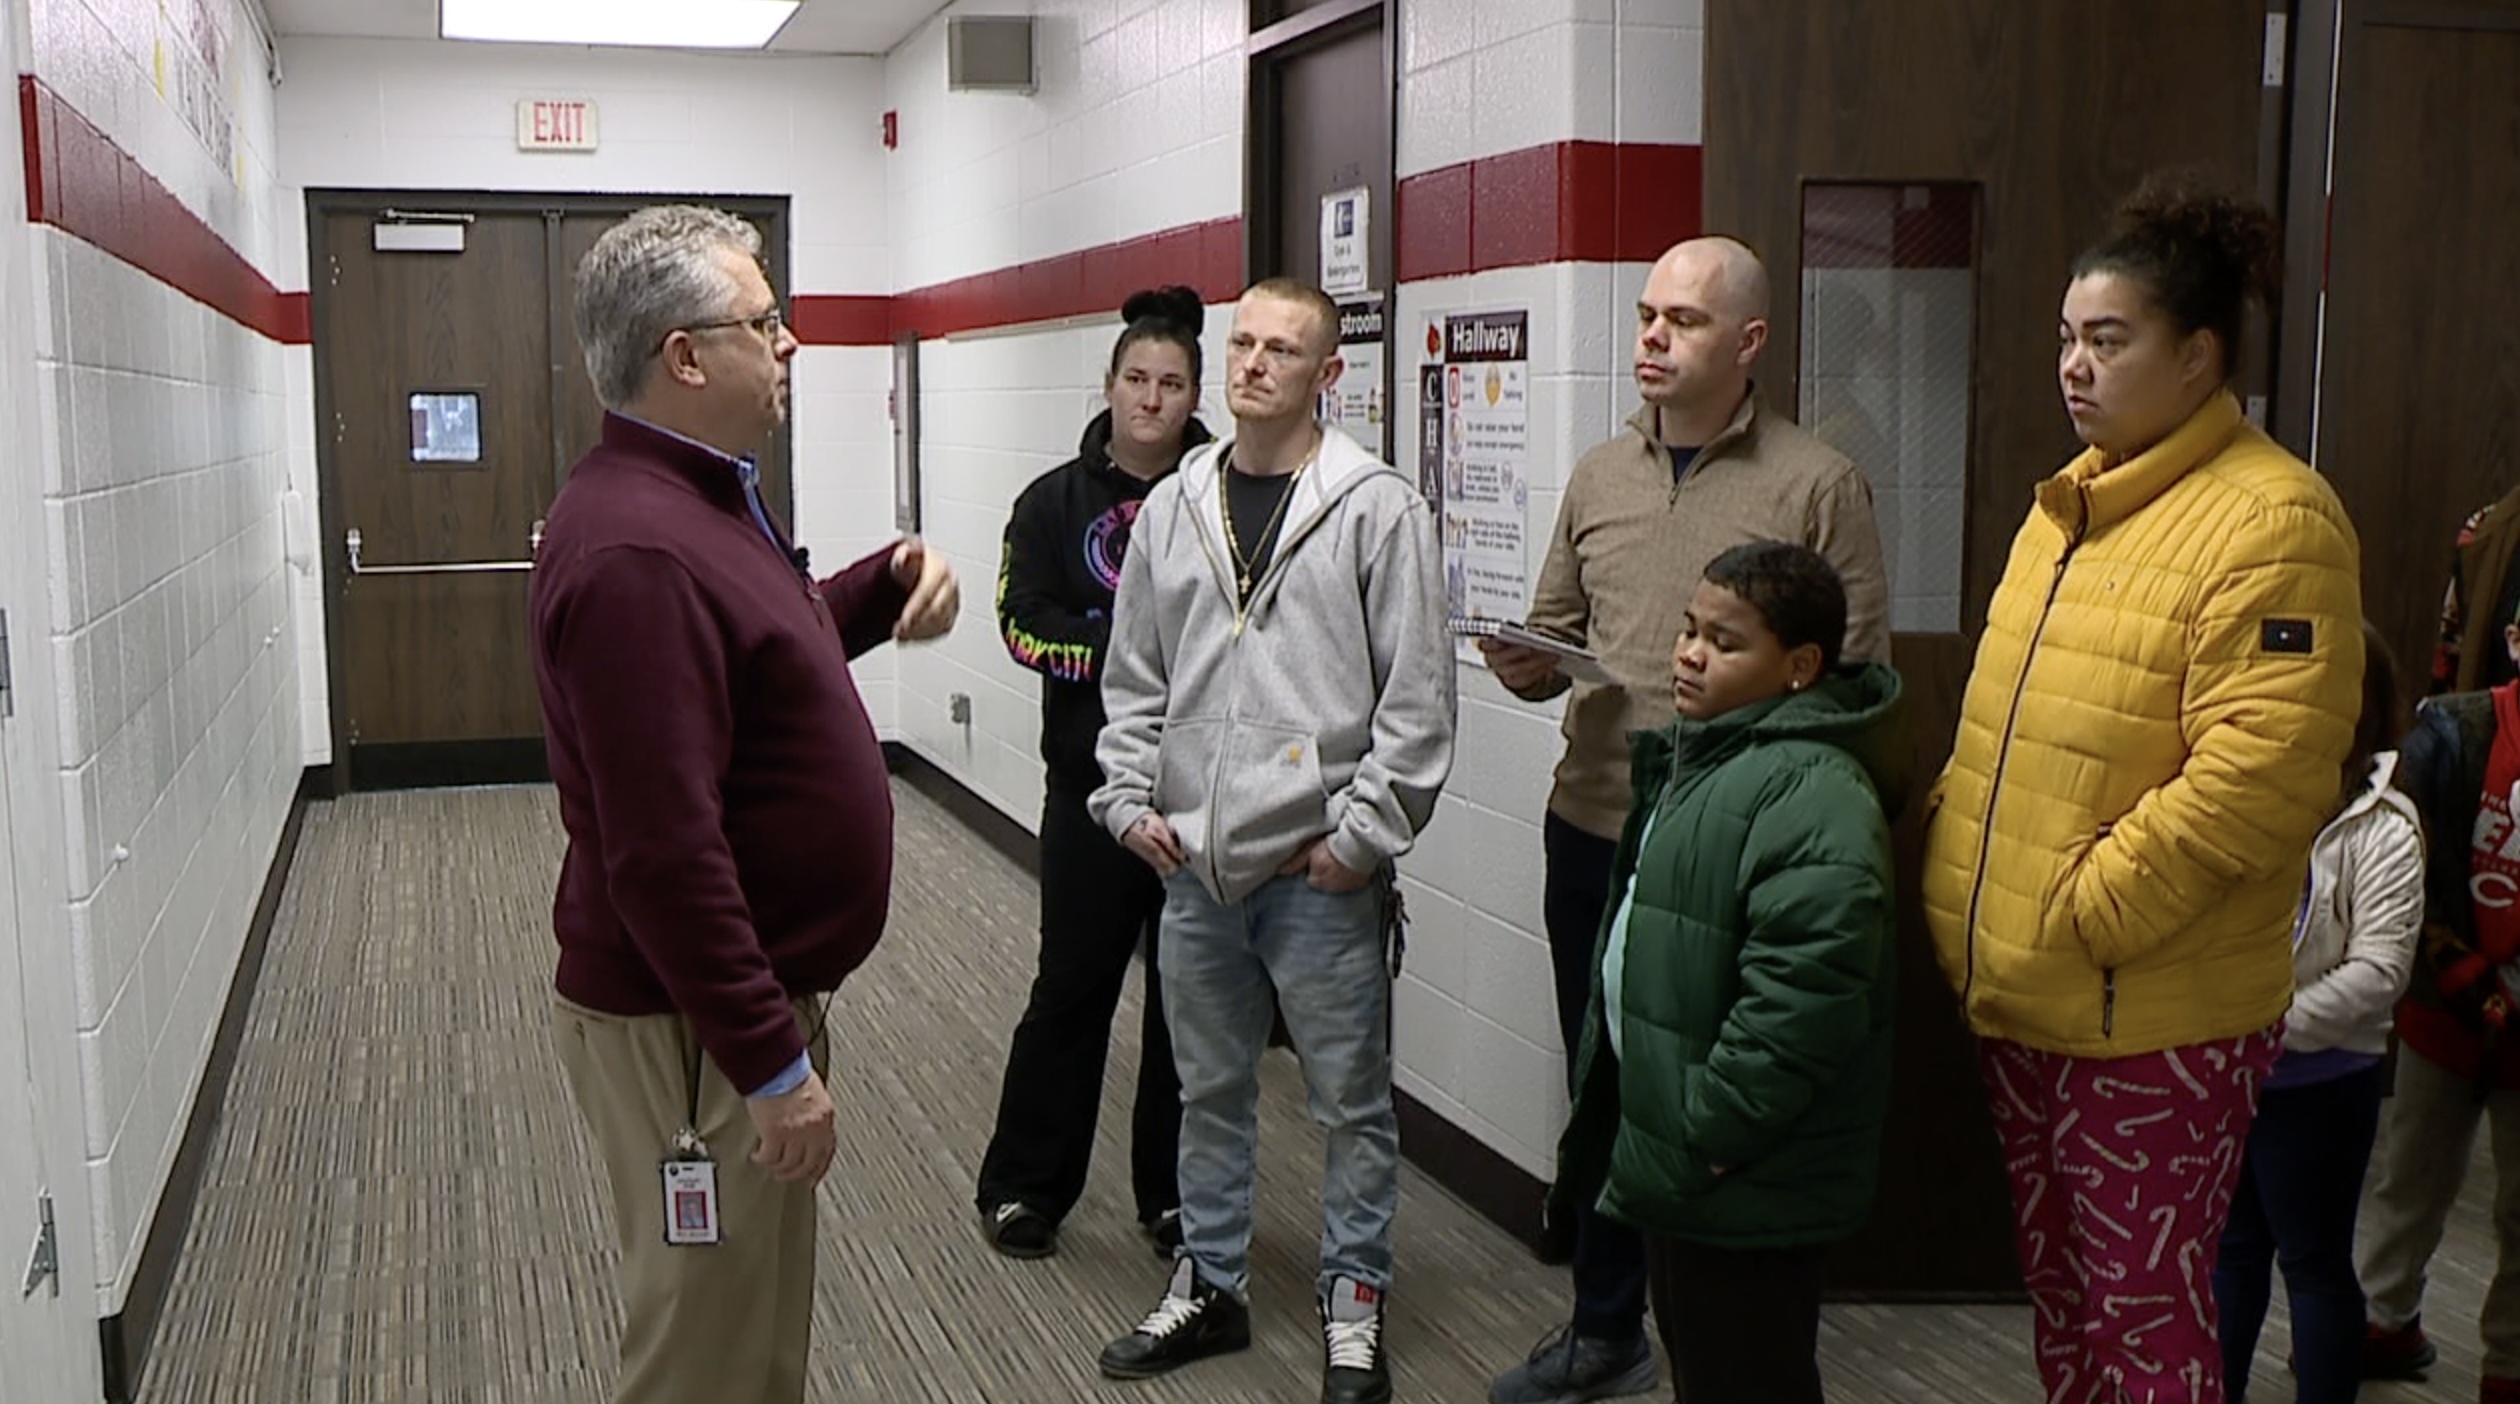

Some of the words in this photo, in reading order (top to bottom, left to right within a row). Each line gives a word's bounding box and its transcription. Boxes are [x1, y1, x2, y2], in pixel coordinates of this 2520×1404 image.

[534, 102, 586, 142] EXIT
[1340, 312, 1383, 336] stroom
[1453, 320, 1520, 358] Hallway
